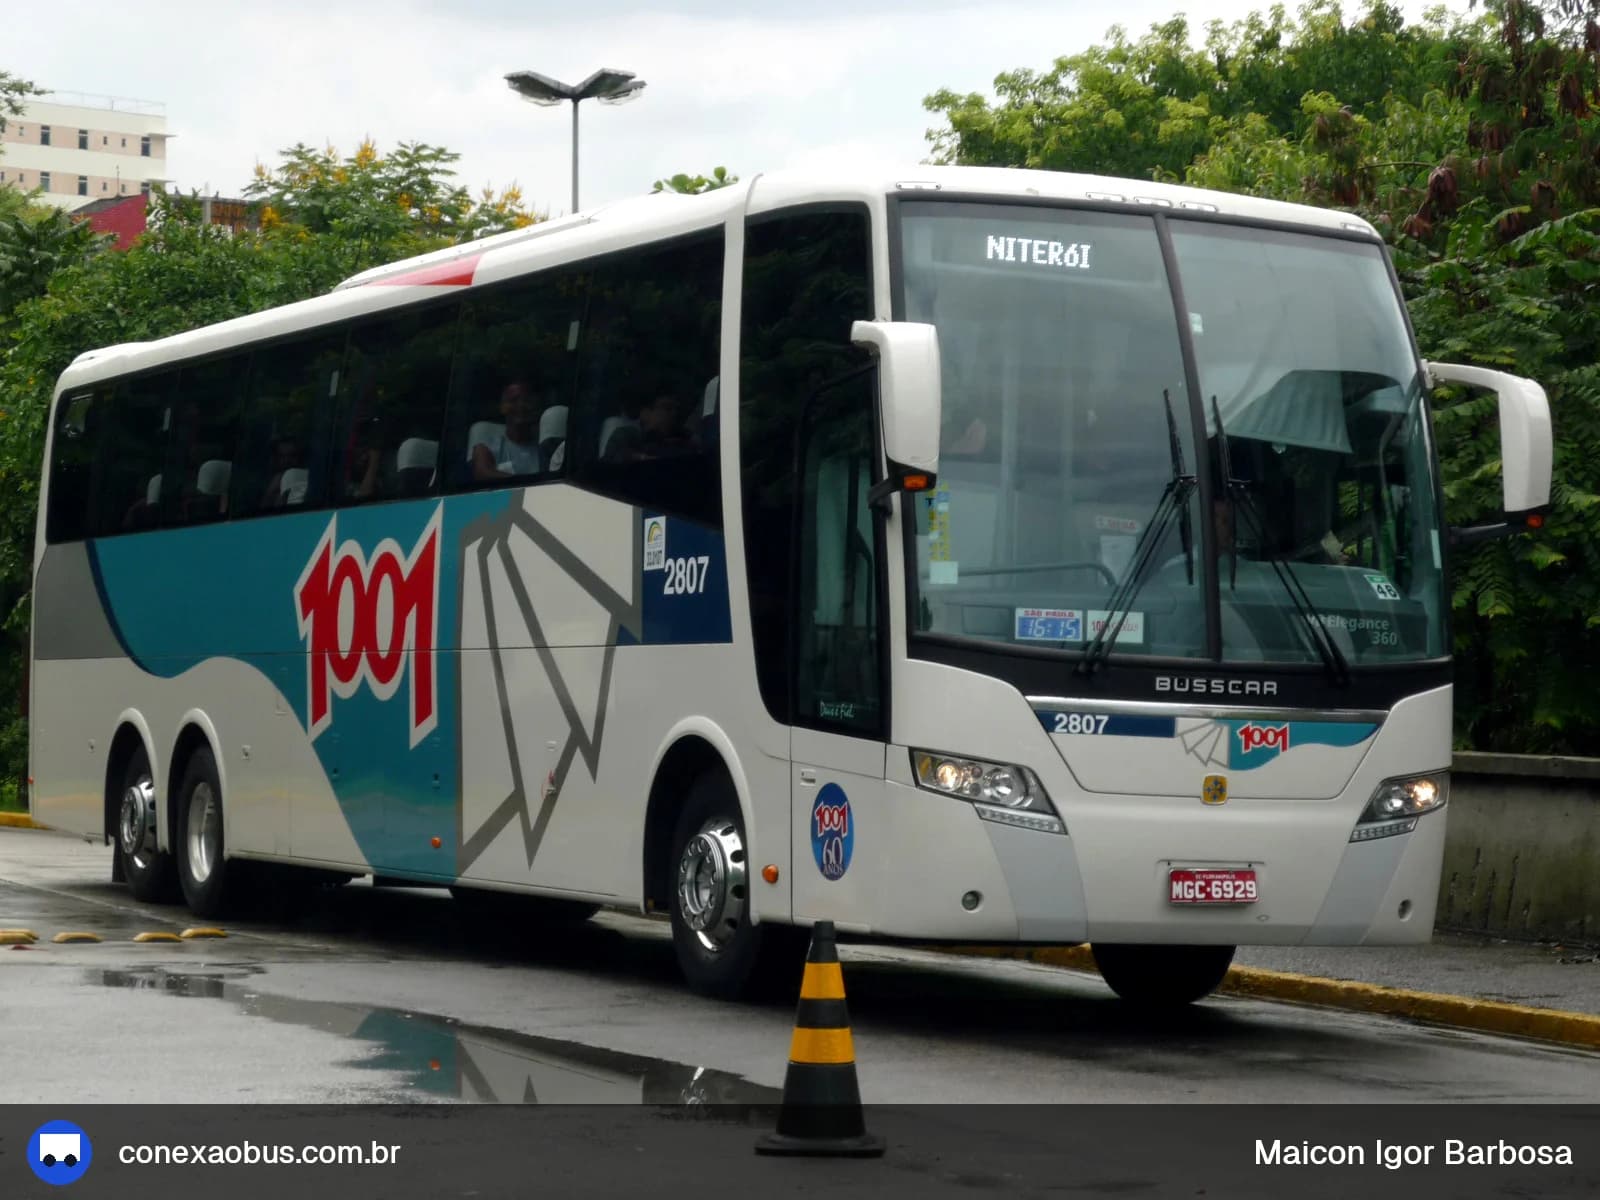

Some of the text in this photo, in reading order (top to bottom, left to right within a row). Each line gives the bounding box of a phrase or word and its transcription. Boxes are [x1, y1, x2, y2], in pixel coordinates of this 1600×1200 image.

[663, 555, 710, 595] 2807
[293, 497, 444, 750] 1001
[1027, 618, 1077, 638] 16:15
[1371, 631, 1398, 646] 360
[1155, 676, 1279, 696] BUSSCAR
[1054, 713, 1109, 736] 2807
[1237, 722, 1290, 755] 1001
[815, 801, 848, 838] 1001
[823, 836, 843, 865] 60
